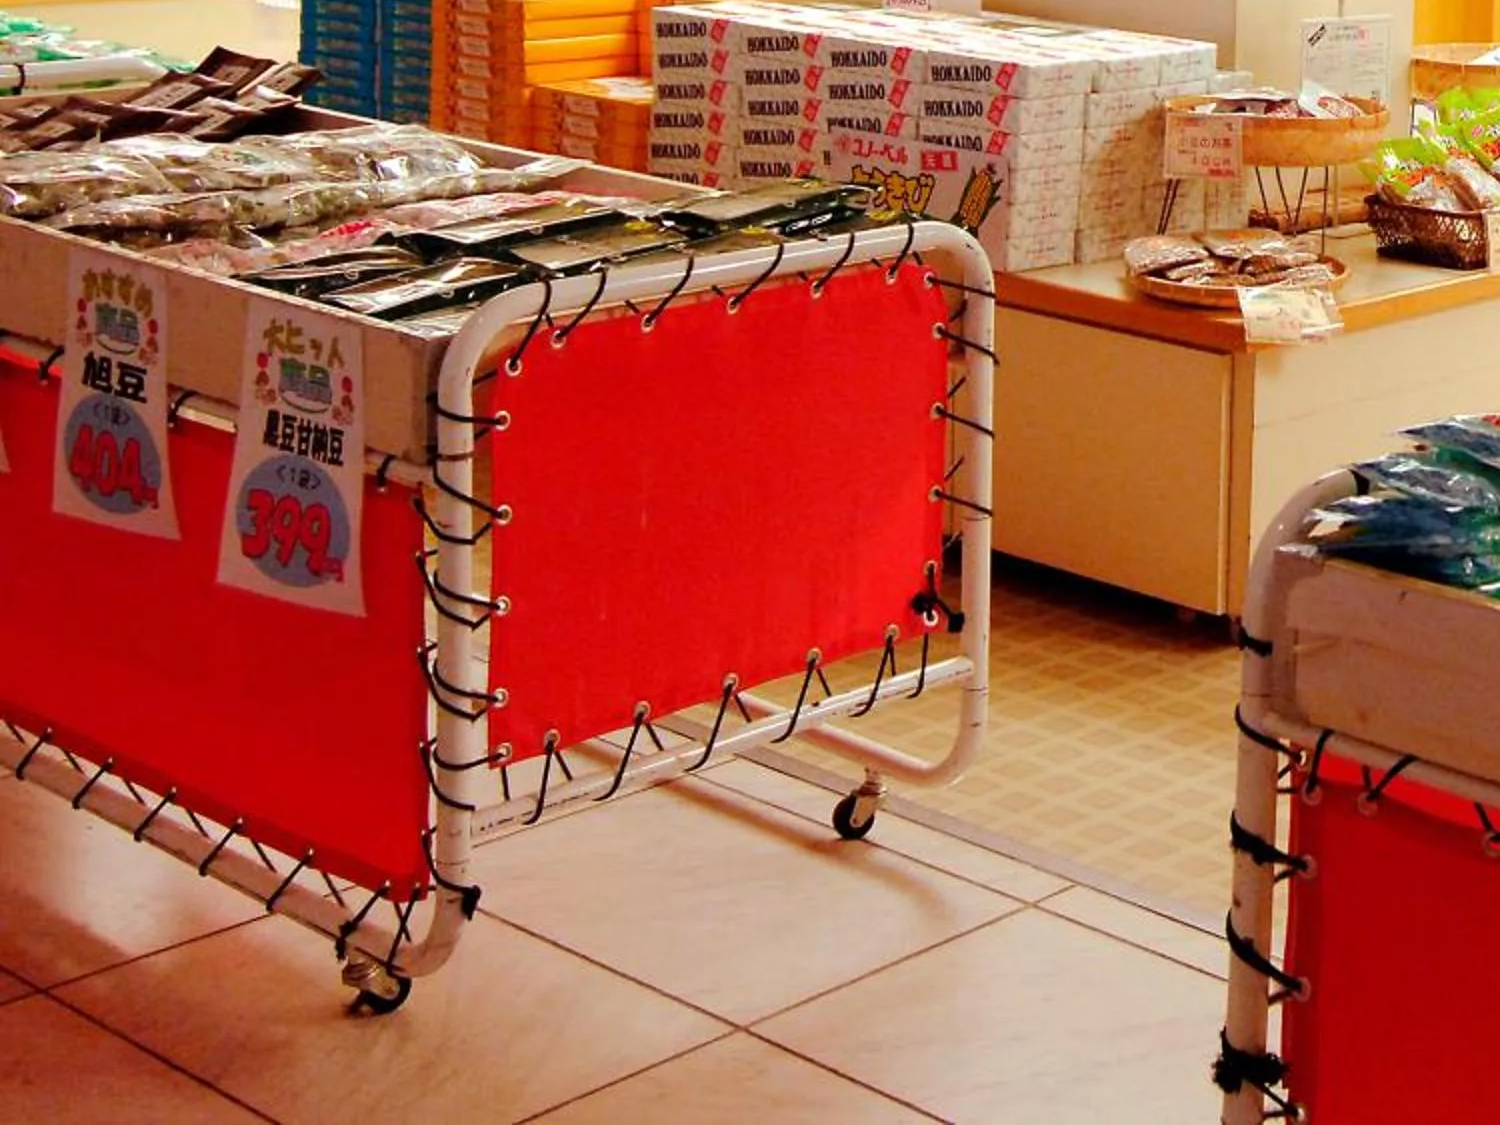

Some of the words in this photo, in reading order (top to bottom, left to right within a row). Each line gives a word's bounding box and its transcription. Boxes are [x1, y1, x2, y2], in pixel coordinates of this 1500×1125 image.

[655, 20, 708, 38] HOKKAIDO
[748, 36, 800, 53] HOKKAIDO
[659, 51, 709, 69] HOKKAIDO
[830, 50, 887, 68] HOKKAIDO
[744, 68, 801, 86] HOKKAIDO
[931, 65, 992, 83] HOKKAIDO
[658, 83, 706, 100] HOKKAIDO
[828, 83, 885, 100] HOKKAIDO
[748, 100, 800, 116] HOKKAIDO
[924, 99, 983, 118] HOKKAIDO
[653, 112, 705, 129] HOKKAIDO
[743, 129, 796, 146] HOKKAIDO
[651, 142, 702, 160] HOKKAIDO
[81, 351, 148, 404] 旭豆
